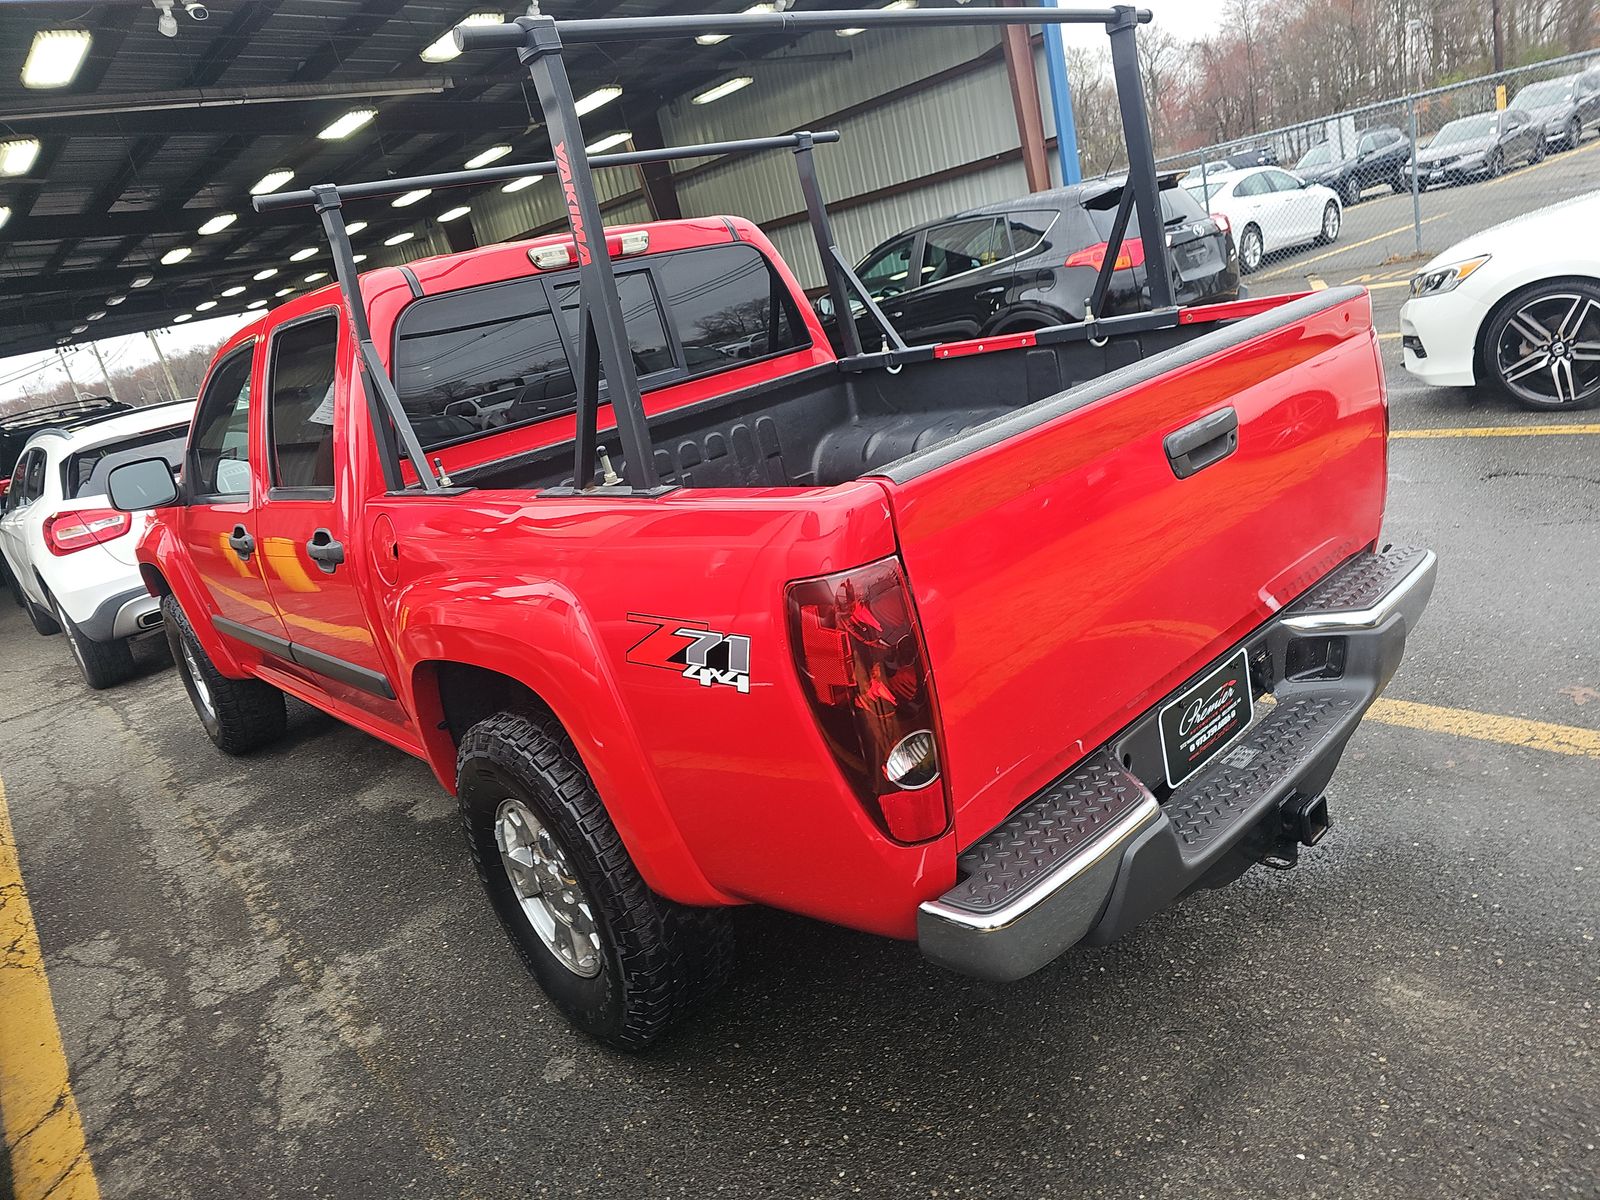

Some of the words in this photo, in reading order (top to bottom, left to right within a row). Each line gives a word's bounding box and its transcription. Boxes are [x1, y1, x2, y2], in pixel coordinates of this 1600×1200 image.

[555, 141, 592, 267] YAKIMA
[626, 612, 751, 675] Z71
[1179, 682, 1235, 736] Premier
